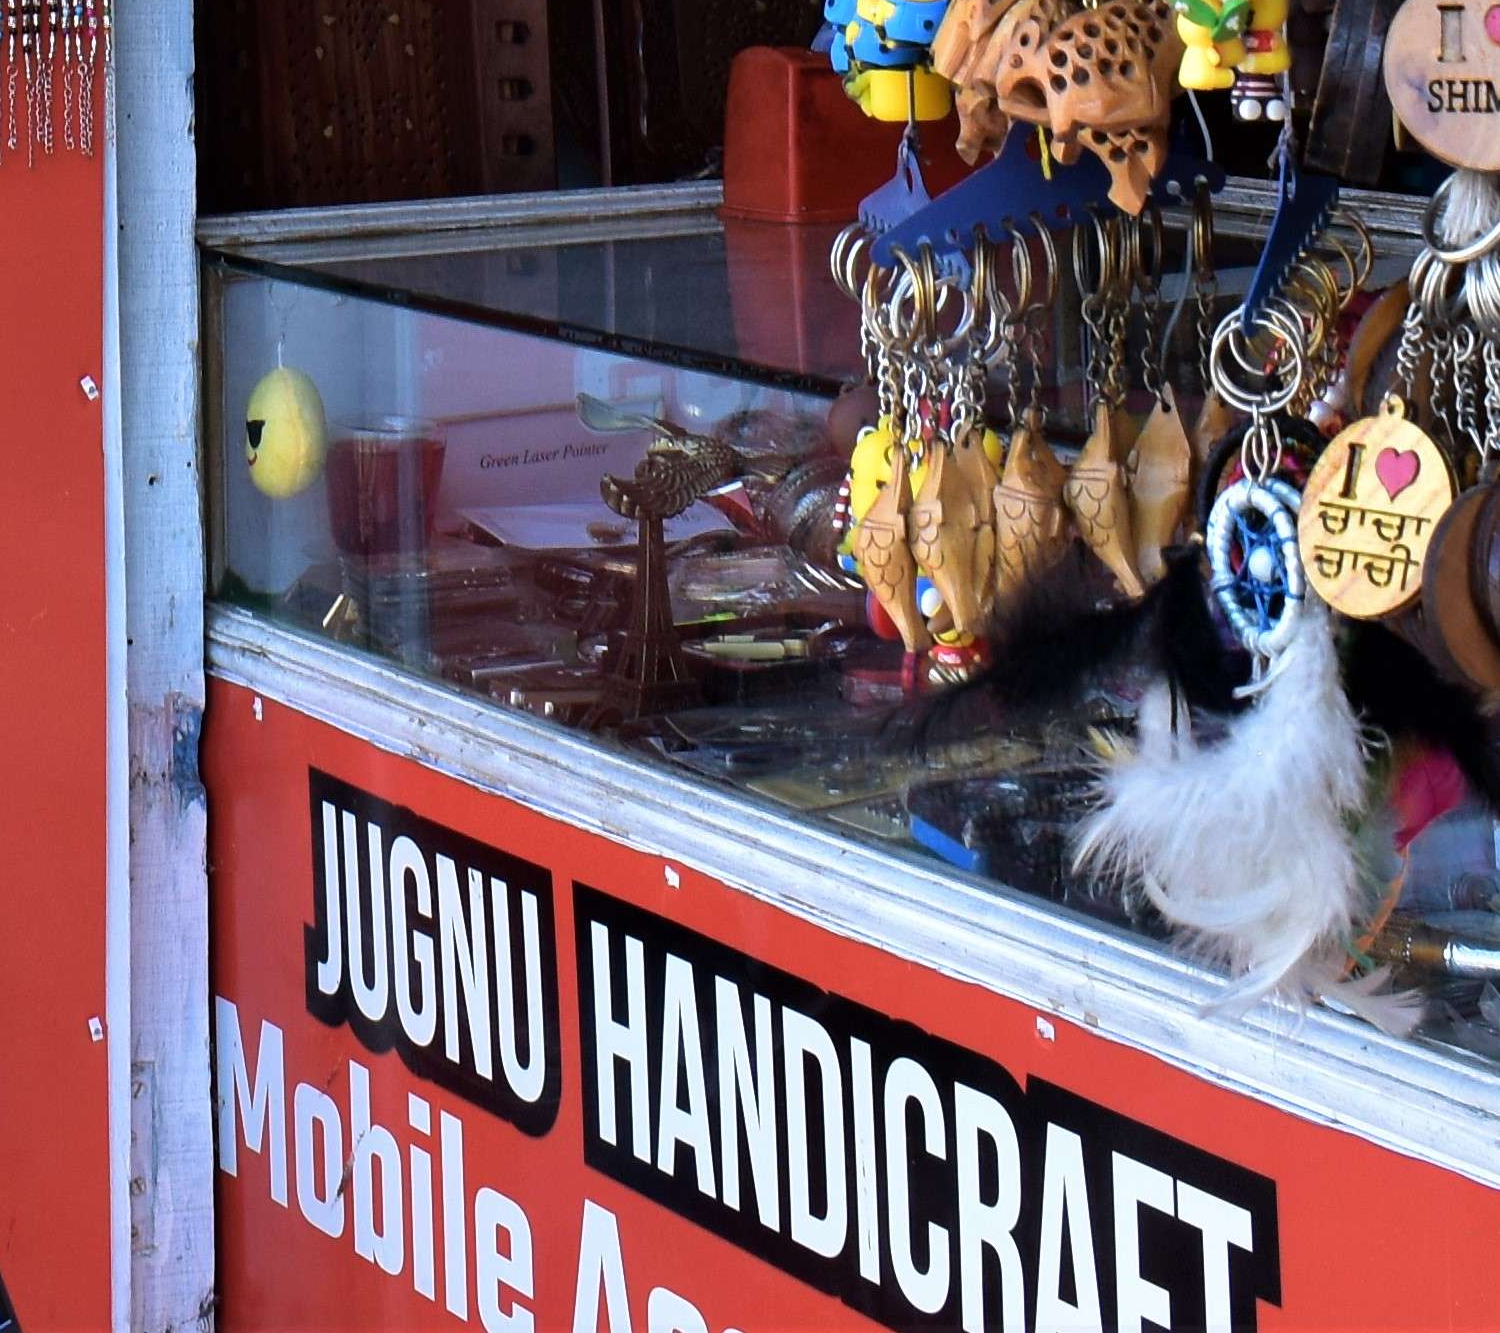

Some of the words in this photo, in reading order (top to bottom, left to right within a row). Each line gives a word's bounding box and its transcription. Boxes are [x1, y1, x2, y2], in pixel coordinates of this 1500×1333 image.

[1435, 2, 1466, 64] I
[480, 453, 519, 469] Green
[523, 449, 559, 465] Laser
[562, 443, 609, 460] Pointer
[1339, 442, 1367, 500] I
[313, 801, 548, 1104] JUGNU
[589, 921, 1254, 1333] HANDICRAFT
[215, 995, 534, 1332] Mobile
